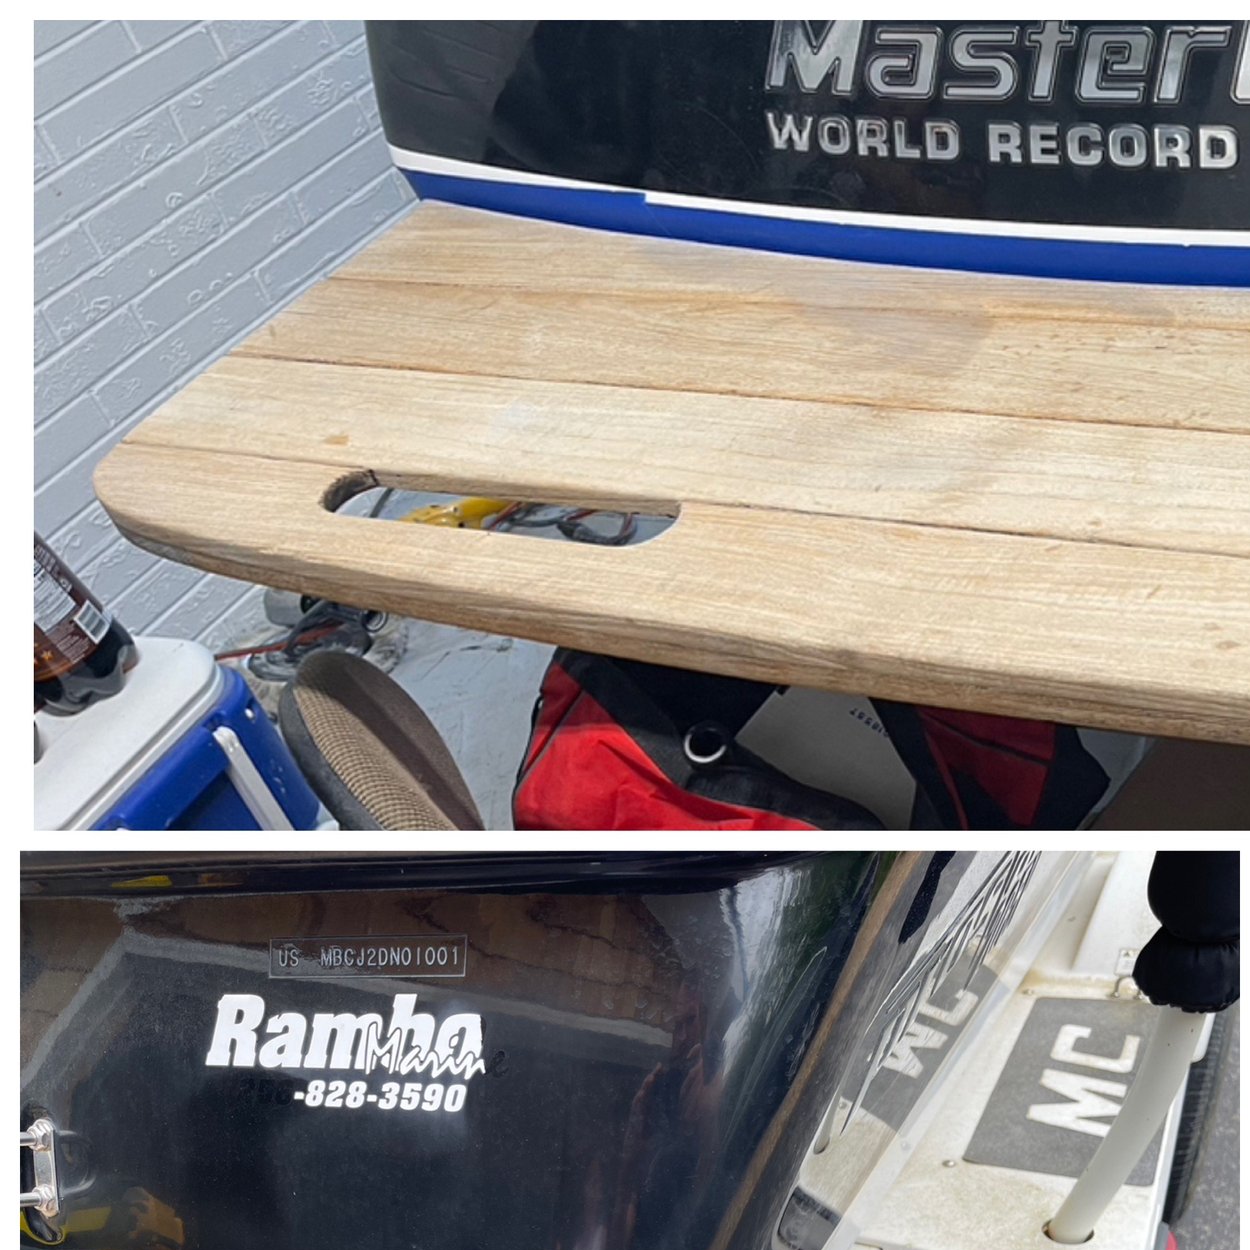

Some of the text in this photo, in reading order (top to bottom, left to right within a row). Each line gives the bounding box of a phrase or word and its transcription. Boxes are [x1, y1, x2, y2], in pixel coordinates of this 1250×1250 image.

[767, 112, 960, 166] WORLD
[986, 119, 1239, 172] RECORD
[278, 948, 300, 967] US
[206, 993, 484, 1069] Rambo
[1026, 1024, 1142, 1138] MC
